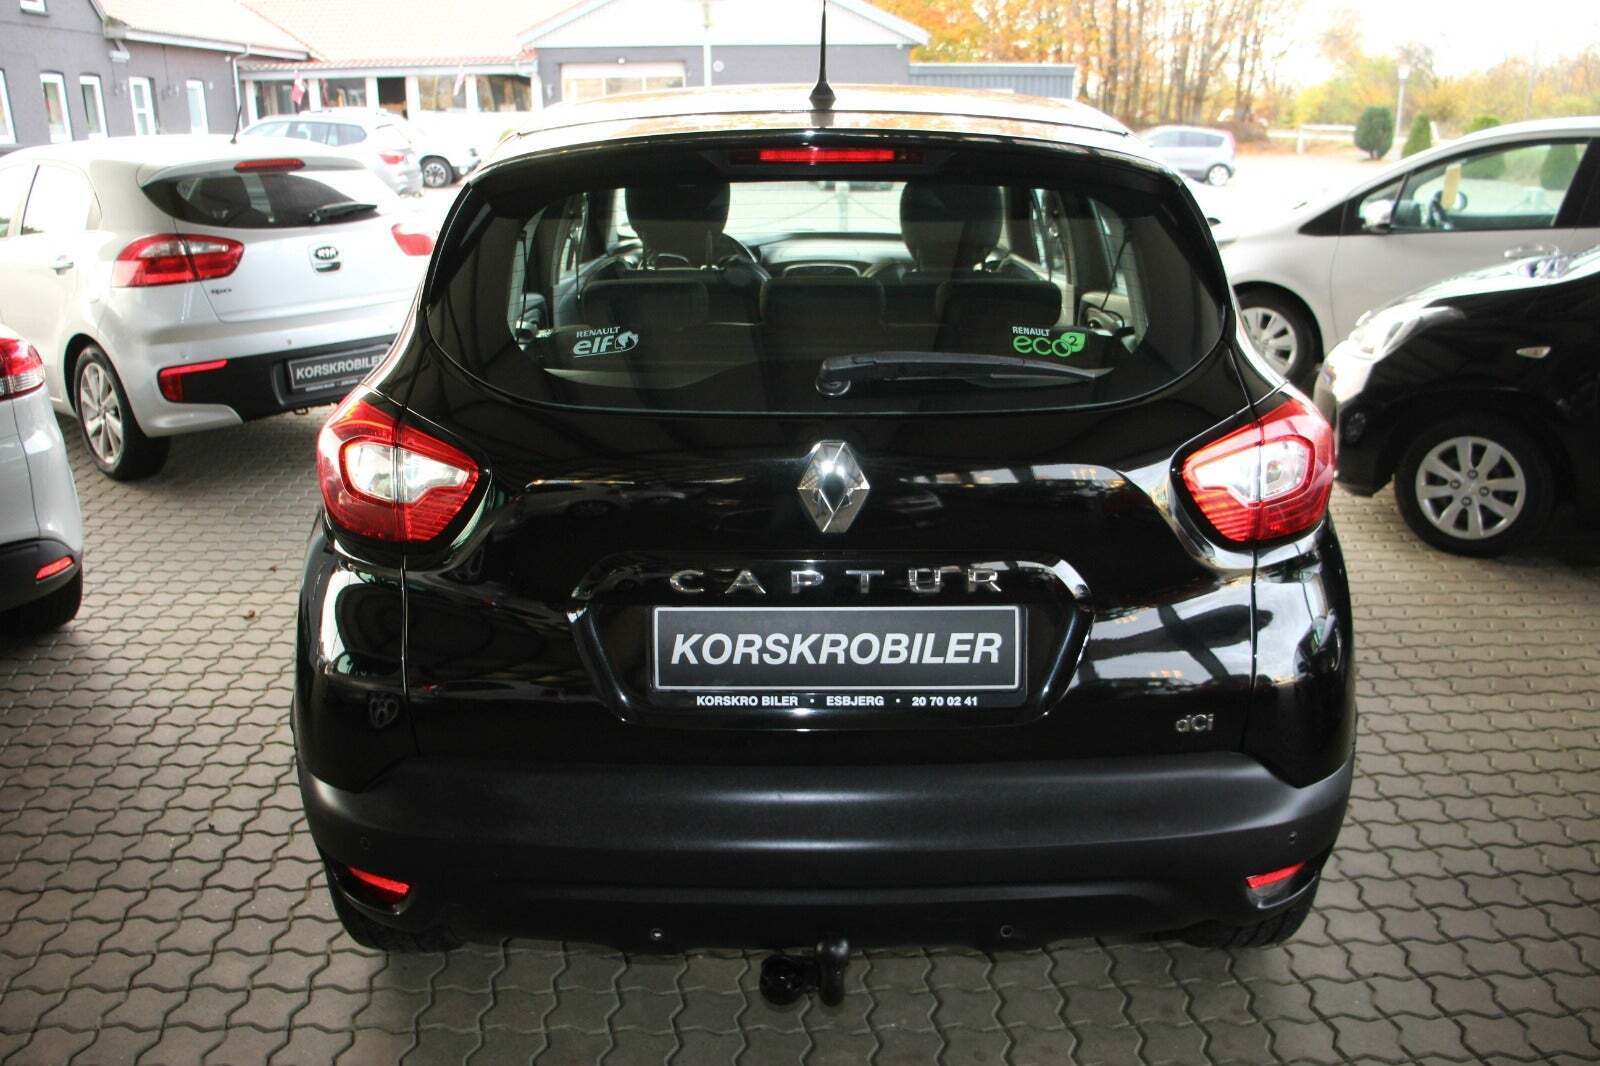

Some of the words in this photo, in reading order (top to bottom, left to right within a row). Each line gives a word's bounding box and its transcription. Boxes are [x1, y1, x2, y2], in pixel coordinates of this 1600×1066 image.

[576, 326, 621, 338] RENAULT
[1012, 326, 1050, 337] RENAULT
[573, 336, 614, 355] elf
[669, 569, 1002, 594] CAPTUR
[671, 632, 1003, 665] KORSKROBILER
[696, 695, 758, 706] KORSKRO
[761, 695, 799, 706] BILER
[826, 695, 884, 706] ESBJERG
[911, 696, 927, 706] 20
[929, 696, 944, 706] 70
[946, 696, 962, 706] 02
[963, 696, 978, 706] 41
[1175, 713, 1214, 732] dCi
